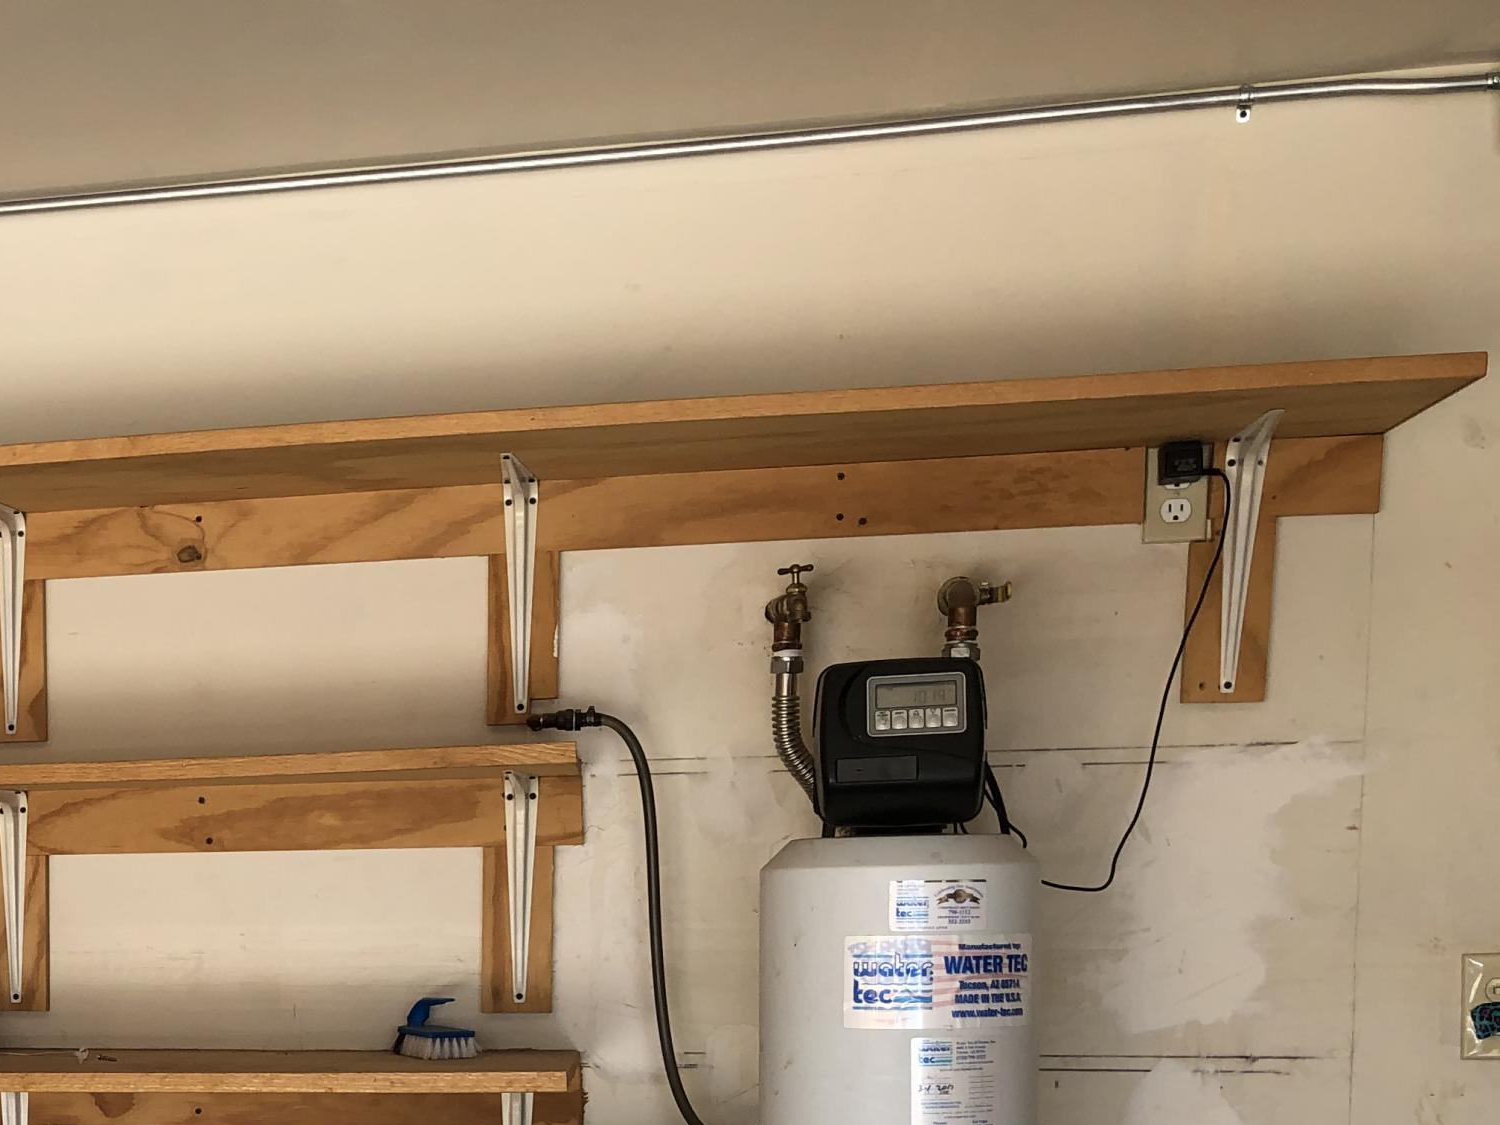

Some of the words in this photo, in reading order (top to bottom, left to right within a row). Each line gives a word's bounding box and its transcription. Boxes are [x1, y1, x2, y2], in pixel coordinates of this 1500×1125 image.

[853, 952, 934, 977] water
[944, 955, 1003, 974] WATER
[1007, 954, 1028, 972] TEC
[853, 978, 893, 1004] tec
[990, 979, 1000, 989] AZ
[955, 993, 979, 1004] MADE
[980, 993, 990, 1003] IN
[991, 993, 1004, 1003] THE
